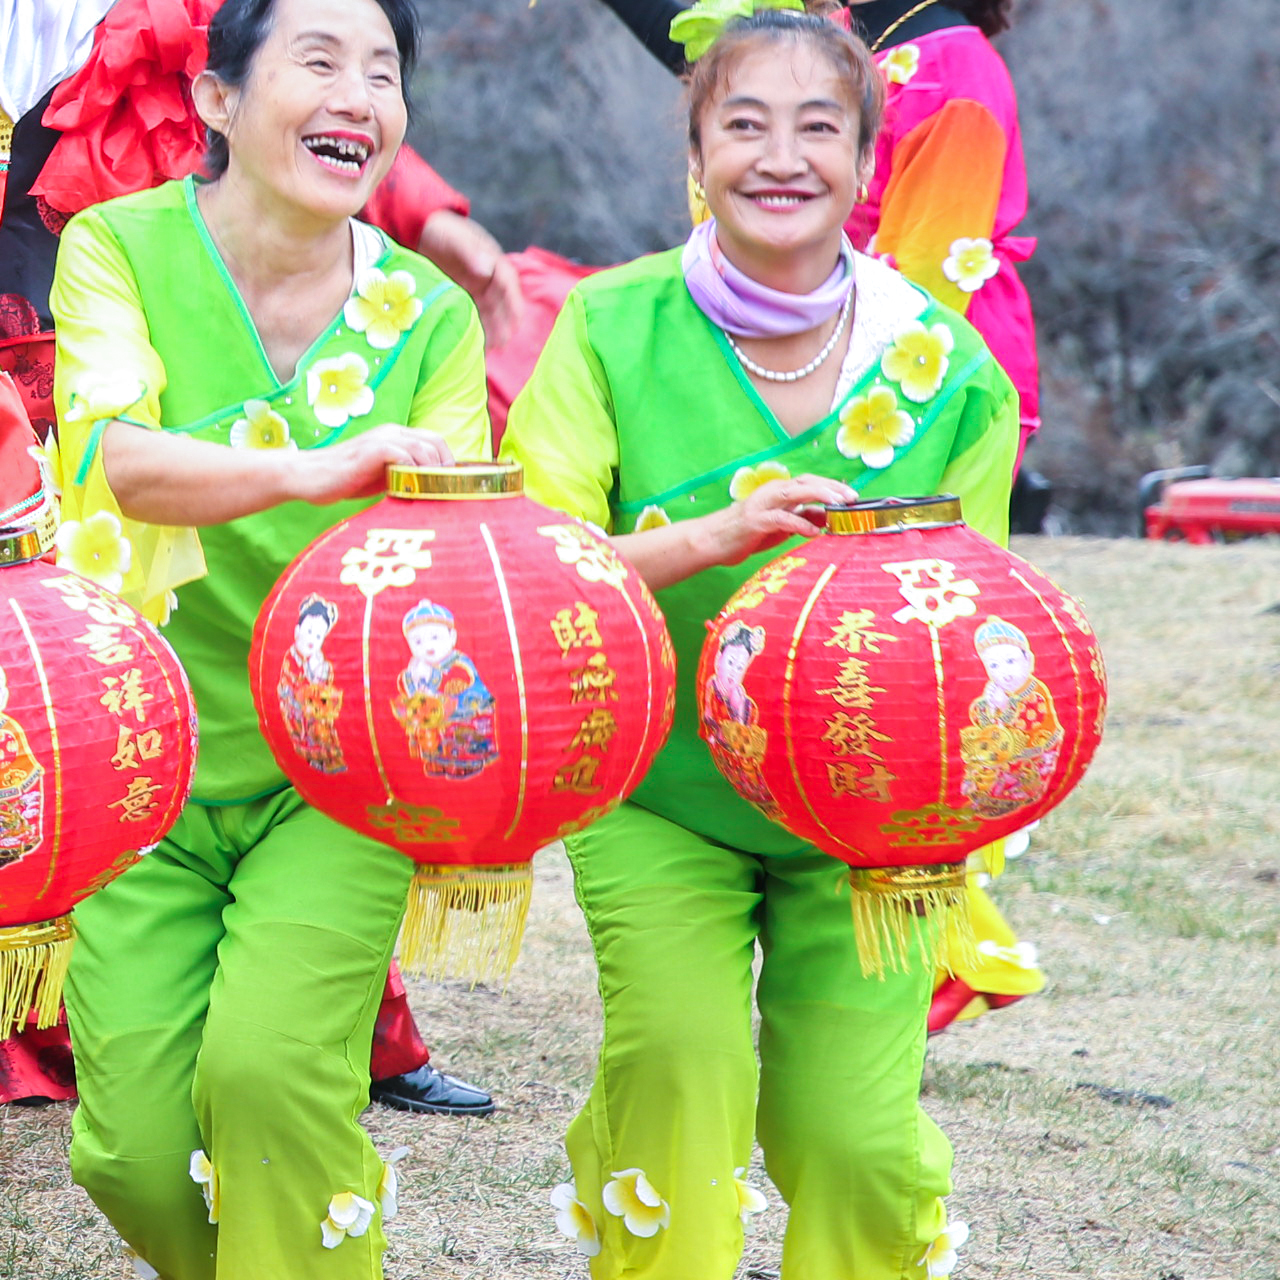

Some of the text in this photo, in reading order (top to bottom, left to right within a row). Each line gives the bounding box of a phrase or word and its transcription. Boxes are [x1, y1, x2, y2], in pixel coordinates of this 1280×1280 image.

[74, 623, 163, 823] 吉祥如意
[815, 608, 898, 803] 恭喜發財
